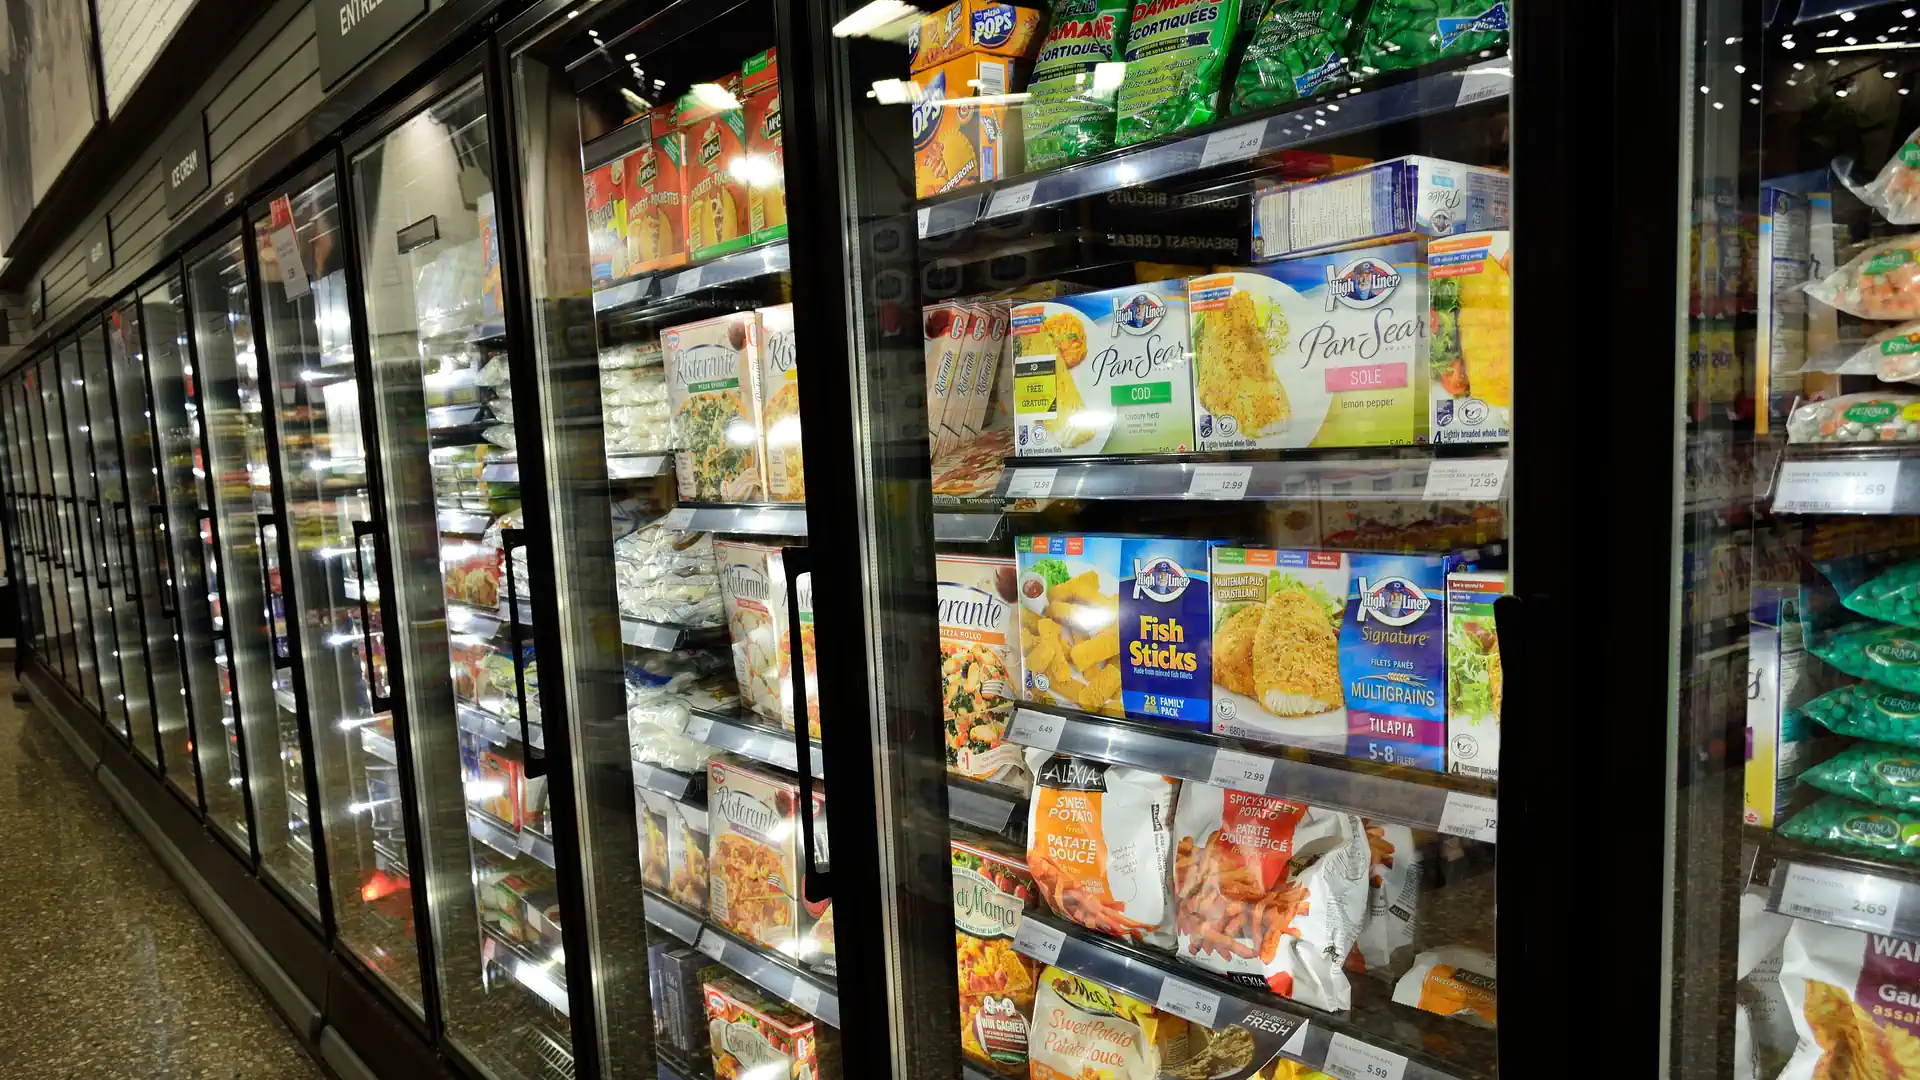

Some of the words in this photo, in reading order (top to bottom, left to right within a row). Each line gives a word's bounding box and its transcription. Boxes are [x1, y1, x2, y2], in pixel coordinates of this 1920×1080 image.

[974, 11, 1013, 45] POPS
[1239, 138, 1259, 151] 2.49
[1331, 277, 1354, 296] High
[1372, 273, 1401, 290] Liner
[1115, 309, 1133, 324] High
[1145, 305, 1166, 319] Liner
[1299, 308, 1427, 370] Pan-Sear
[674, 345, 737, 387] Ristorante
[1092, 334, 1184, 386] Pan-Sear
[934, 347, 954, 398] Ristorante
[957, 350, 976, 398] Ristorante
[976, 351, 995, 399] Ristorante
[1350, 370, 1382, 385] SOLE
[1026, 384, 1044, 393] FREE!
[1126, 387, 1151, 400] COD
[1341, 399, 1364, 409] lemon
[1366, 398, 1394, 409] pepper
[1848, 406, 1891, 417] FERMA
[1146, 412, 1160, 420] herb
[1461, 429, 1481, 440] breaded
[1221, 480, 1243, 489] 12.99
[1469, 478, 1499, 488] 12.99
[1138, 571, 1155, 588] High
[1168, 573, 1189, 588] Liner
[1250, 577, 1265, 587] PLUS
[1363, 592, 1386, 608] High
[1402, 594, 1428, 611] Liner
[960, 631, 982, 641] POLLO
[1140, 614, 1184, 643] Fish
[1361, 626, 1427, 647] Signature
[1129, 640, 1197, 672] Sticks
[1875, 645, 1918, 661] FERMA
[1371, 657, 1391, 668] FILETS
[1393, 658, 1414, 670] PANÉS
[1143, 695, 1156, 706] 28
[1160, 696, 1184, 709] FAMILY
[1351, 682, 1436, 707] MULTIGRAINS
[1160, 706, 1179, 717] PACK
[1038, 725, 1053, 733] 6.49
[1229, 725, 1241, 735] 680
[1369, 717, 1415, 738] TILAPIA
[1368, 742, 1394, 763] 5-8
[1397, 755, 1416, 767] FILETS
[1042, 763, 1099, 785] ALEXIA
[1243, 770, 1265, 782] 12.99
[1055, 796, 1088, 809] SWEET
[1229, 794, 1257, 807] SPICY
[1257, 797, 1300, 815] SWEET
[1239, 806, 1278, 821] POTATO
[1236, 823, 1271, 838] PATATE
[1852, 820, 1892, 835] FERMA
[1047, 834, 1097, 851] PATATE
[1048, 847, 1096, 864] DOUCE
[956, 887, 969, 908] di
[966, 884, 1017, 927] Mama
[1852, 899, 1887, 916] 2.69
[1042, 941, 1057, 952] 4.49
[1195, 1001, 1212, 1014] 5.99
[981, 1017, 996, 1029] WIN
[996, 1019, 1026, 1034] GAGNER
[1242, 1014, 1292, 1037] FRESH
[1250, 1009, 1286, 1026] FEATURED
[1048, 1008, 1089, 1036] Sweet
[1090, 1021, 1133, 1048] Potato
[1044, 1031, 1087, 1057] Patate
[1366, 1063, 1388, 1079] 5.99
